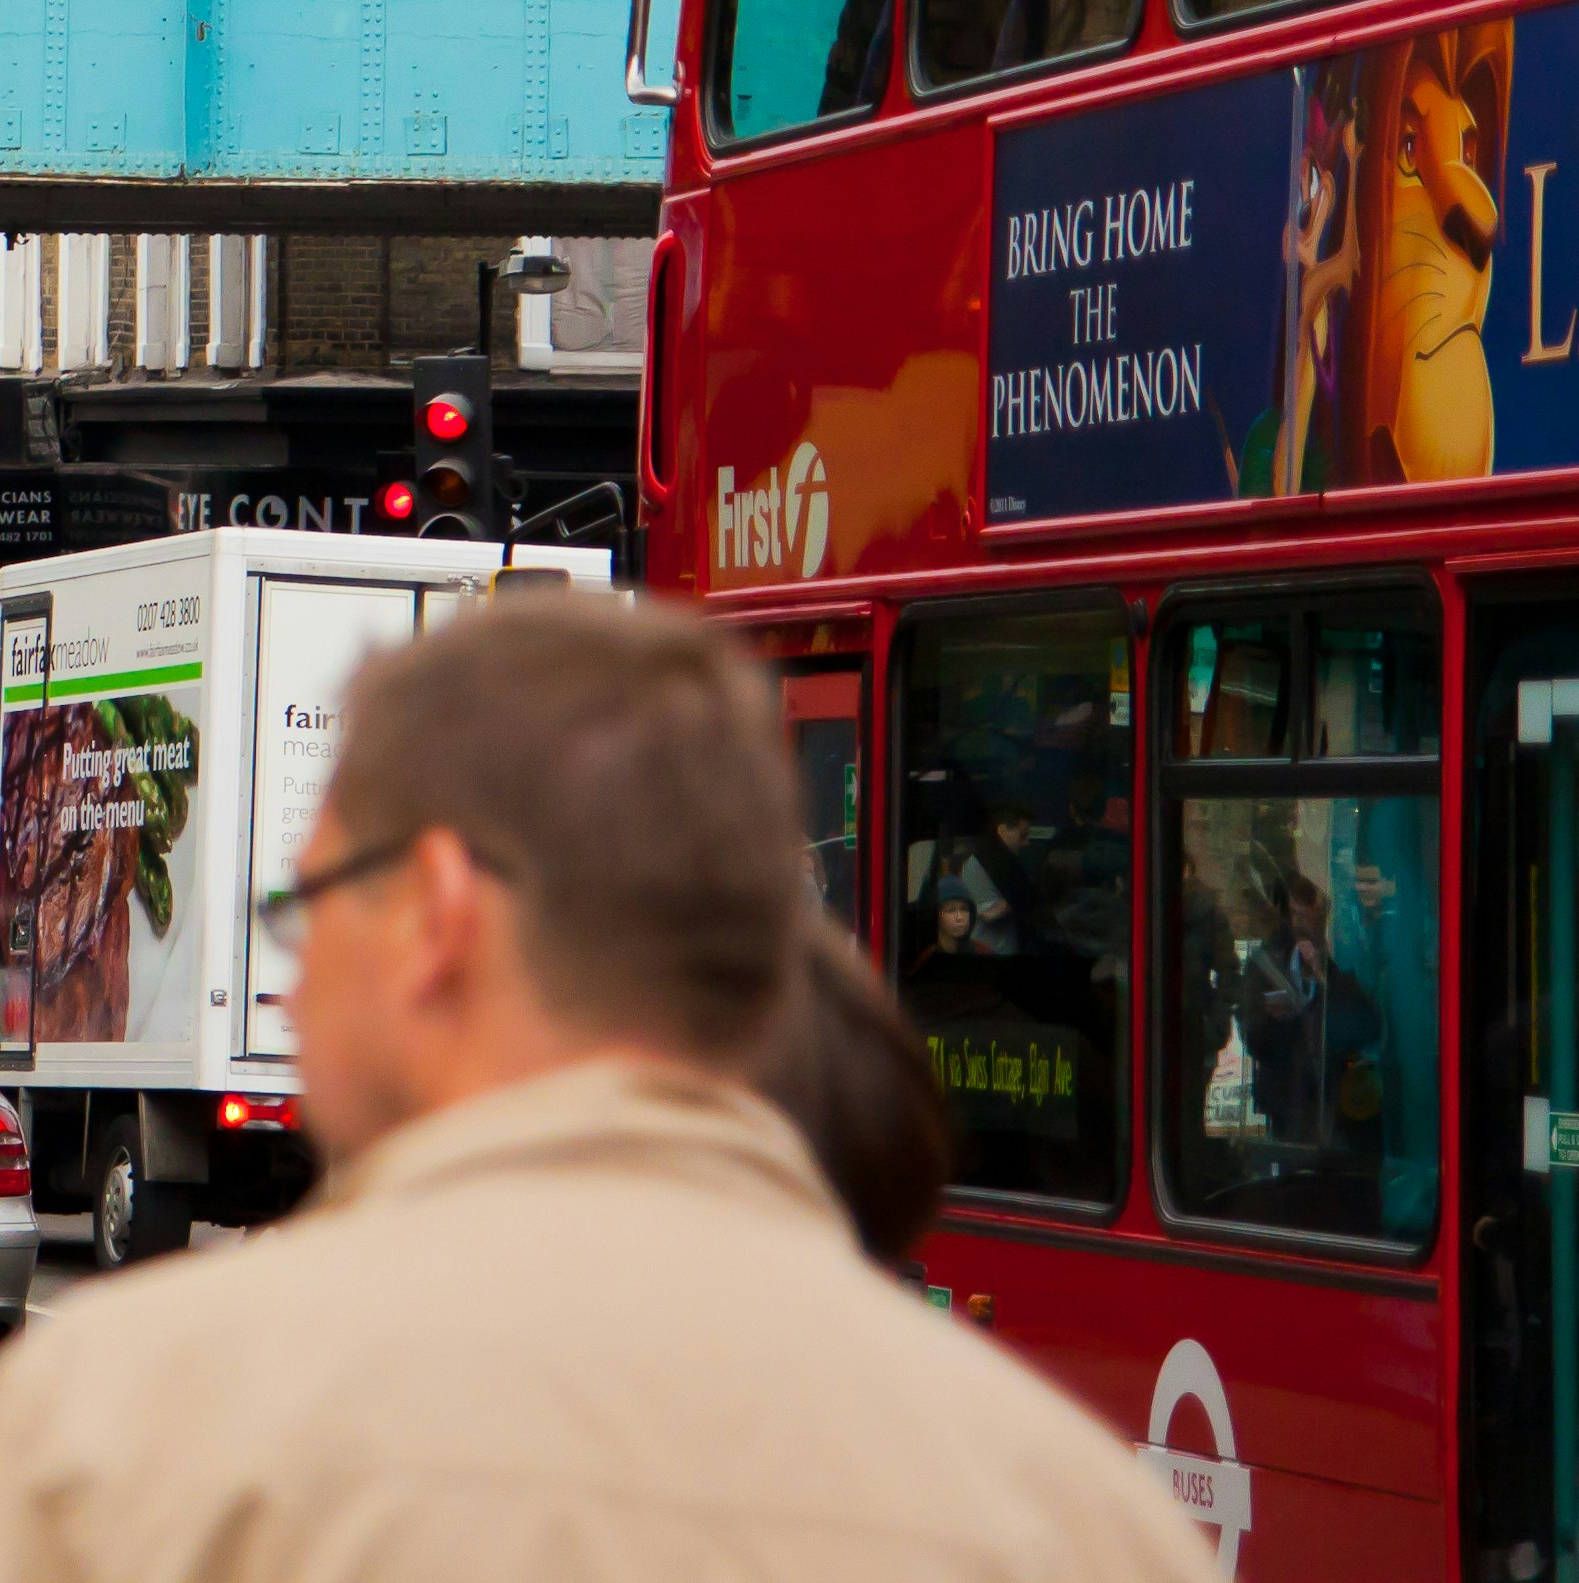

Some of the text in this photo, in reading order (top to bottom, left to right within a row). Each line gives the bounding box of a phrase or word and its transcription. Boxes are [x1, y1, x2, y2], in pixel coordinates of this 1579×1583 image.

[1006, 179, 1194, 280] BRING HOME
[1069, 283, 1118, 344] THE
[991, 343, 1202, 439] PHENOMENON
[178, 492, 212, 531] EYE
[717, 466, 782, 568] First
[25, 531, 53, 542] 1701
[136, 596, 201, 632] 0207 428 3800
[63, 736, 190, 788] Putting great meat
[60, 805, 77, 832] on
[80, 793, 102, 831] the
[1172, 1469, 1215, 1509] BUSES
